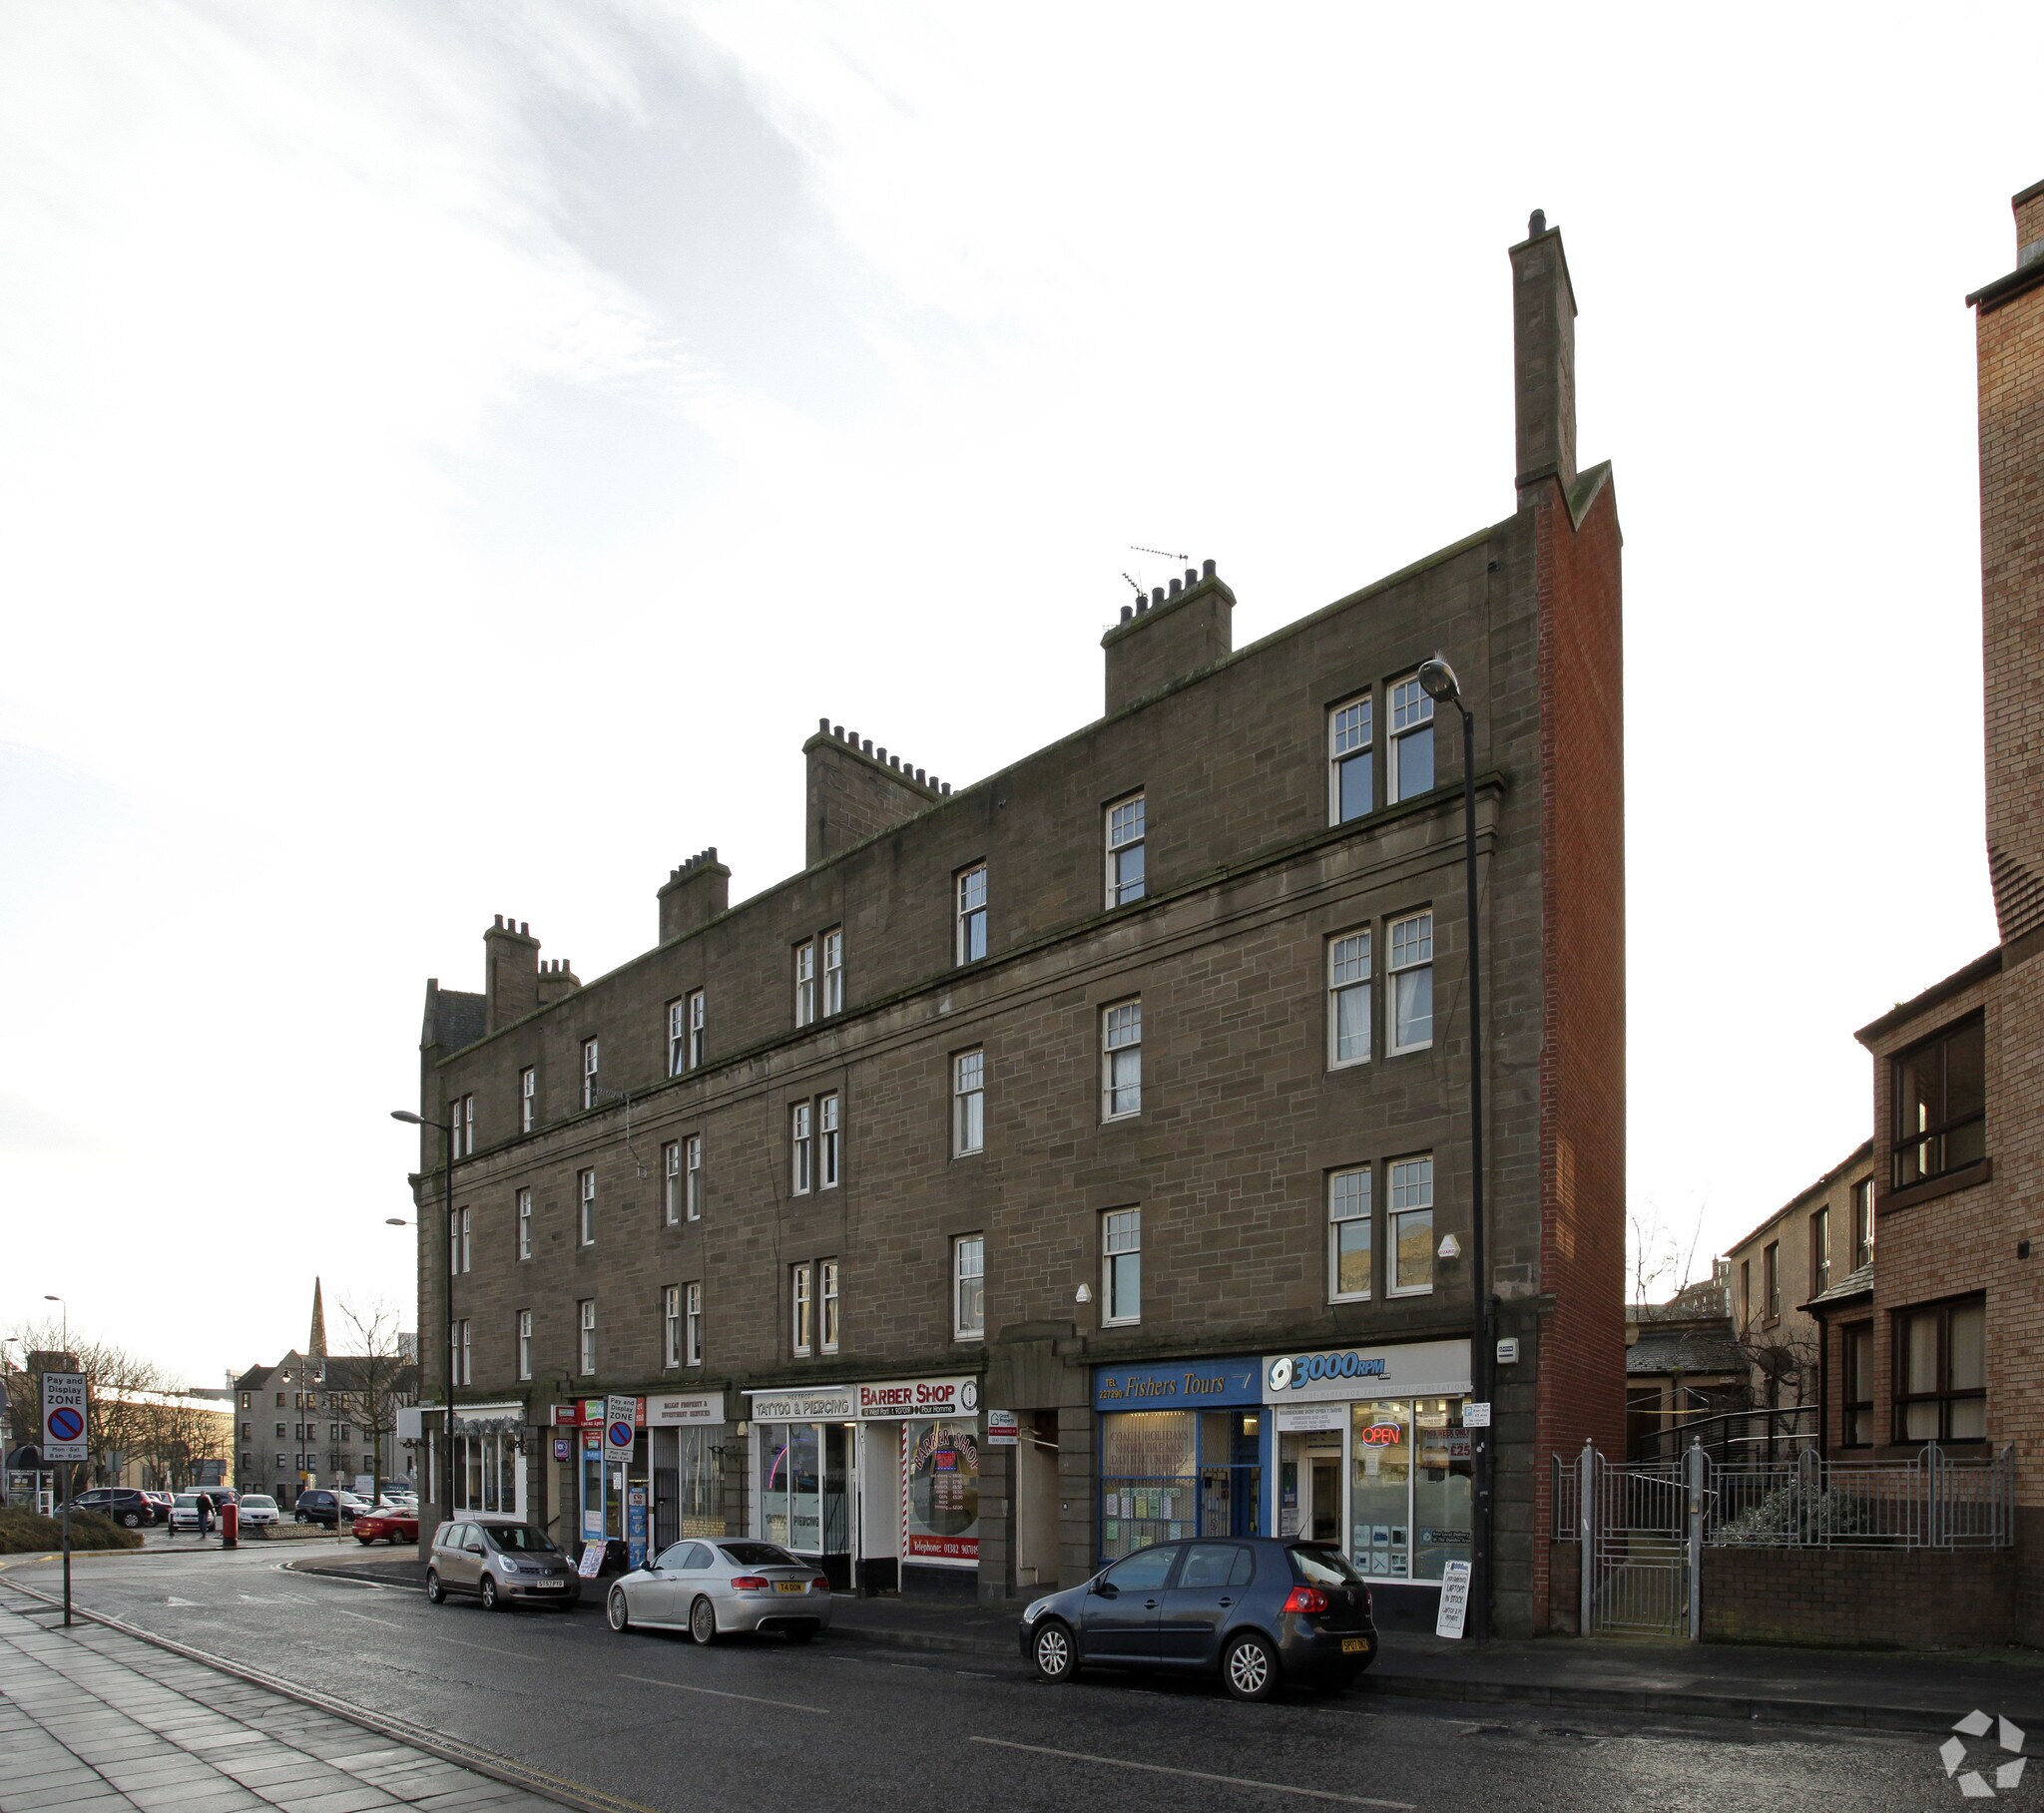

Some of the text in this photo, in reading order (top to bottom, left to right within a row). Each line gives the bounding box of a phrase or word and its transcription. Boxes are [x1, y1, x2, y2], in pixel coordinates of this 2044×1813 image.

[47, 1376, 63, 1385] Pay
[1105, 1378, 1117, 1387] TEL
[1125, 1373, 1226, 1397] Fishers Tours
[48, 1385, 82, 1394] Display
[860, 1387, 913, 1405] BARBER
[916, 1383, 955, 1403] SHOP
[1099, 1389, 1123, 1399] 227290
[1381, 1386, 1409, 1395] DIGITAL
[1415, 1384, 1466, 1394] GENERATION
[47, 1395, 82, 1404] ZONE
[756, 1399, 849, 1416] TATTOO & PIERCING
[610, 1412, 632, 1420] ZONE
[1144, 1430, 1188, 1440] HOLIDAYS
[1362, 1427, 1400, 1443] OPEN
[1455, 1429, 1470, 1437] ONLY
[914, 1428, 950, 1470] BARBER
[1450, 1445, 1471, 1456] £25
[793, 1515, 819, 1527] PIERCING
[944, 1543, 959, 1554] 01382
[1447, 1585, 1465, 1593] LAPTOPS
[1450, 1595, 1464, 1603] STOCK
